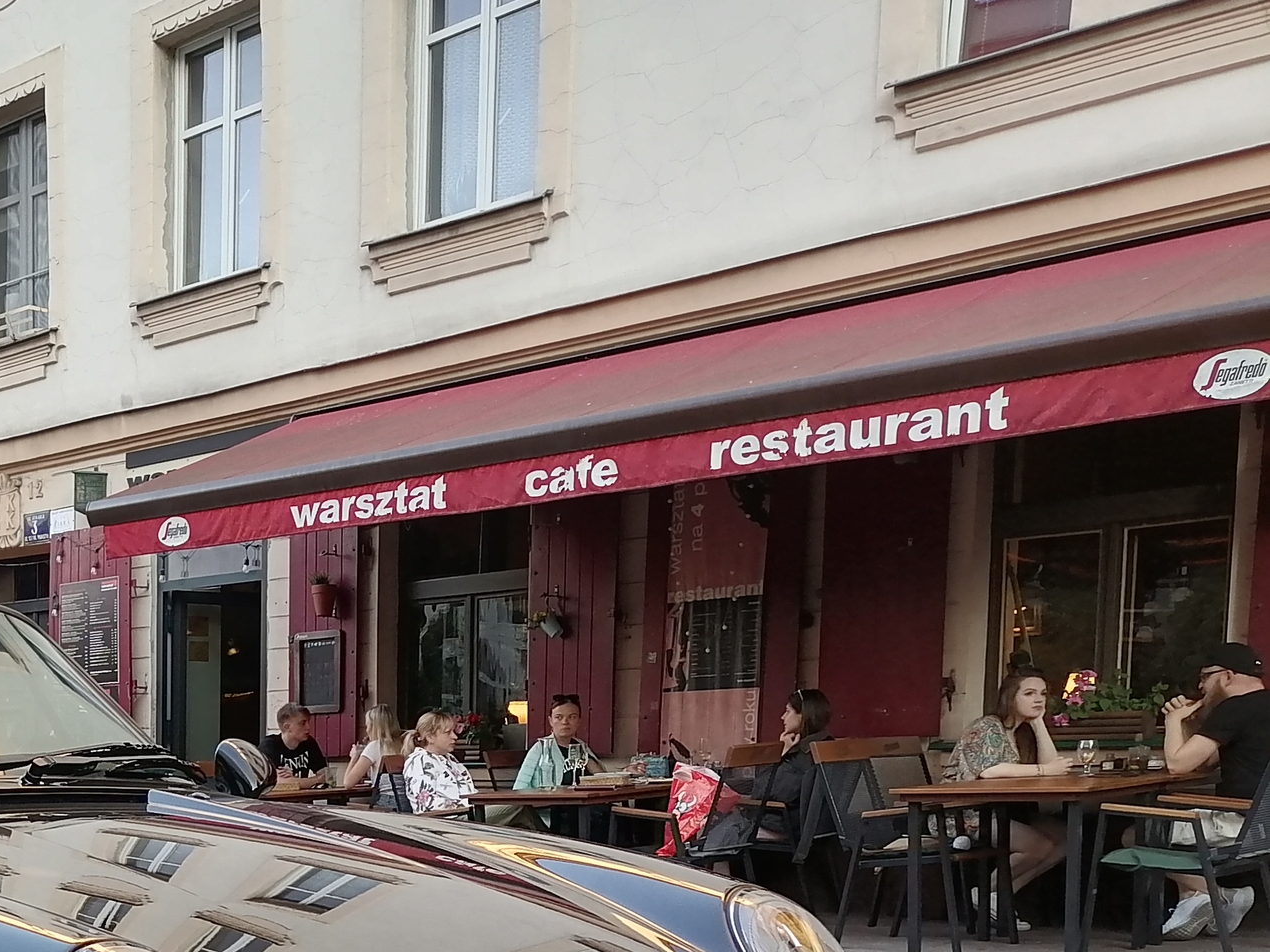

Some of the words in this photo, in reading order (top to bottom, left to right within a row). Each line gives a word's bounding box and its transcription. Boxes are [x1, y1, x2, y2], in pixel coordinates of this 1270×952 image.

[1200, 357, 1267, 391] Segafredo
[710, 386, 1009, 470] restaurant
[524, 454, 619, 498] cafe
[290, 475, 447, 529] warsztat
[691, 503, 705, 517] 4
[31, 520, 38, 534] 3
